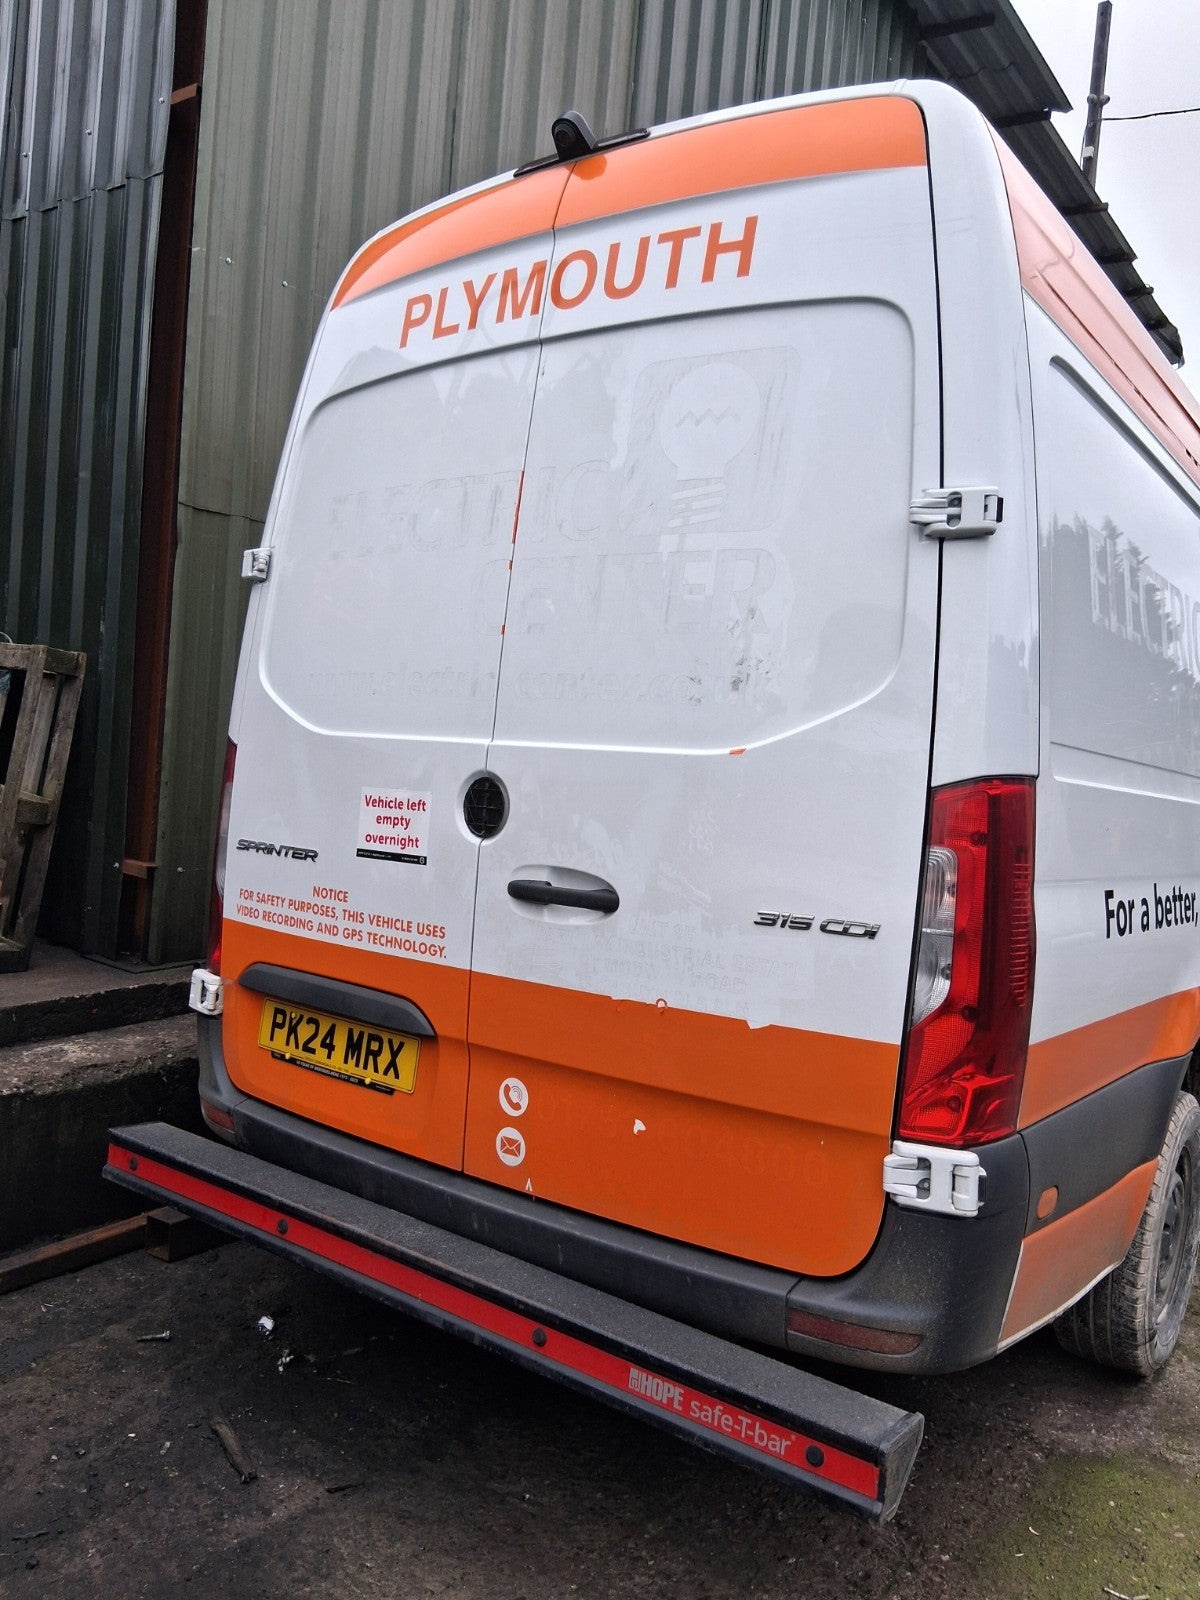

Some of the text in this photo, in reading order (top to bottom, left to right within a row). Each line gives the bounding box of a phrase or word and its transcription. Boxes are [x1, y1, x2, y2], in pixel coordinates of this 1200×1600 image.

[399, 215, 759, 350] PLYMOUTH
[365, 795, 427, 812] Vehicle left
[376, 815, 411, 830] empty
[236, 839, 319, 862] SPRINTER
[365, 834, 420, 850] overnight
[312, 886, 349, 903] NOTICE
[1104, 882, 1199, 940] For a better,
[239, 888, 446, 939] FOR SAFETY PURPOSES, THIS VEHICLE USES
[753, 910, 881, 940] 315 CDI
[236, 904, 447, 959] VIDEO RECORDING AND GPS TECHNOLOGY.
[269, 1006, 405, 1080] PK24 MRX
[639, 1372, 684, 1411] HOPE
